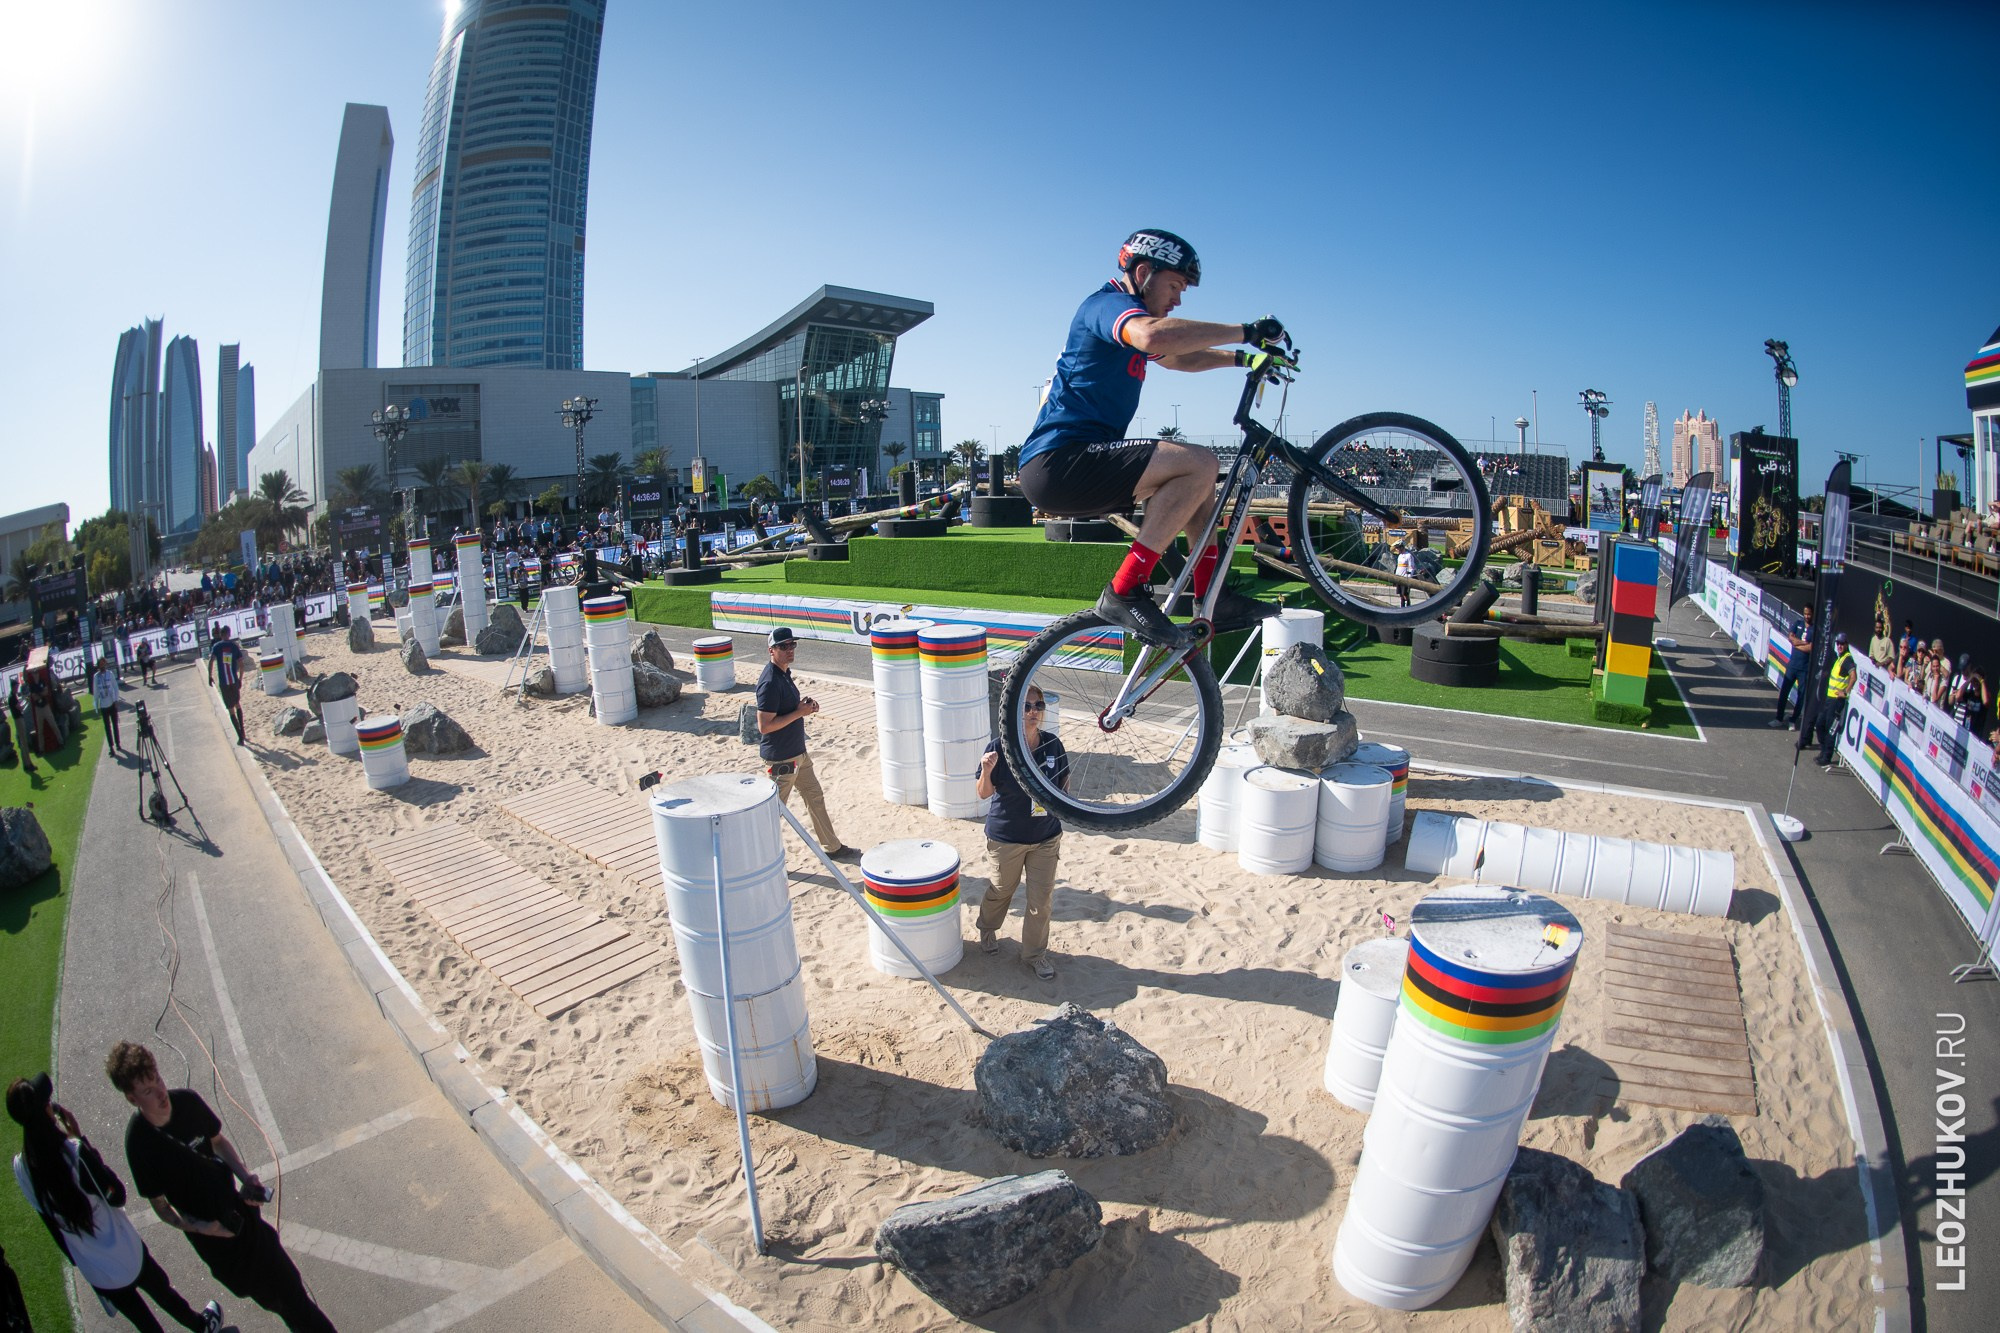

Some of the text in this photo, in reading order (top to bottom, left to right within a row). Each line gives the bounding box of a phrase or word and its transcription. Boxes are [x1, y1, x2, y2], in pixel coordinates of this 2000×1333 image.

[1129, 243, 1183, 266] BIKES
[1134, 233, 1183, 255] TRIAL
[430, 397, 461, 413] VOX
[1109, 439, 1152, 451] CONTROL
[632, 492, 660, 503] 14:36:29
[1846, 707, 1865, 753] CI
[1931, 725, 1943, 746] UCI
[1973, 760, 1988, 784] UCI
